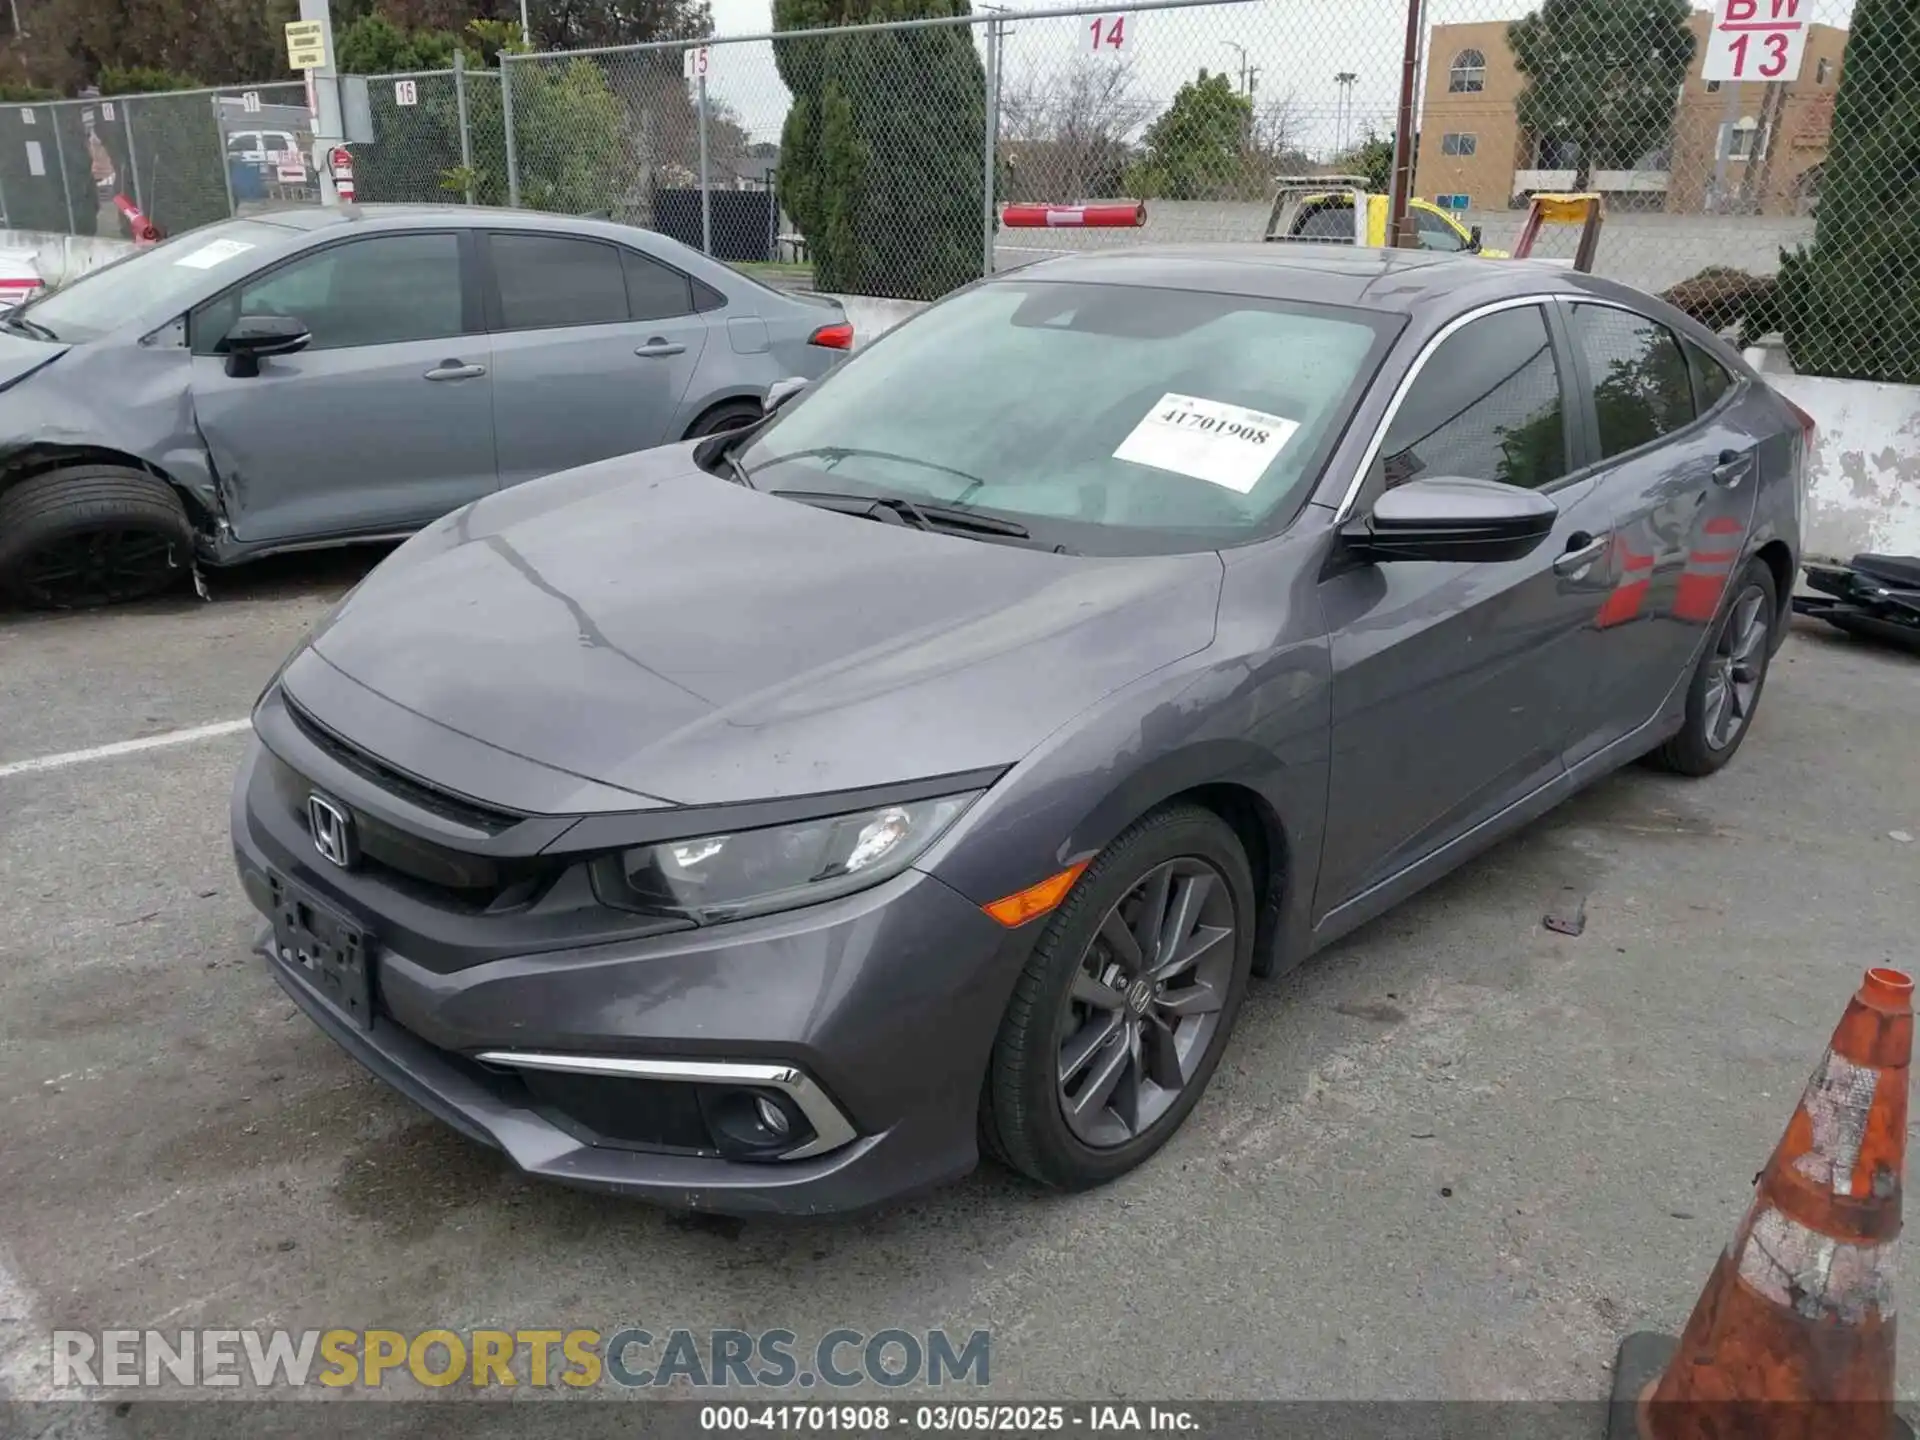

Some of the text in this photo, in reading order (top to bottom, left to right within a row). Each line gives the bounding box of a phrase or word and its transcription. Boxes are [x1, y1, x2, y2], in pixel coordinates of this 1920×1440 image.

[1090, 15, 1124, 49] 14
[689, 48, 708, 74] 15
[1728, 33, 1789, 77] 13
[400, 82, 414, 103] 16
[1162, 409, 1270, 445] 41701908
